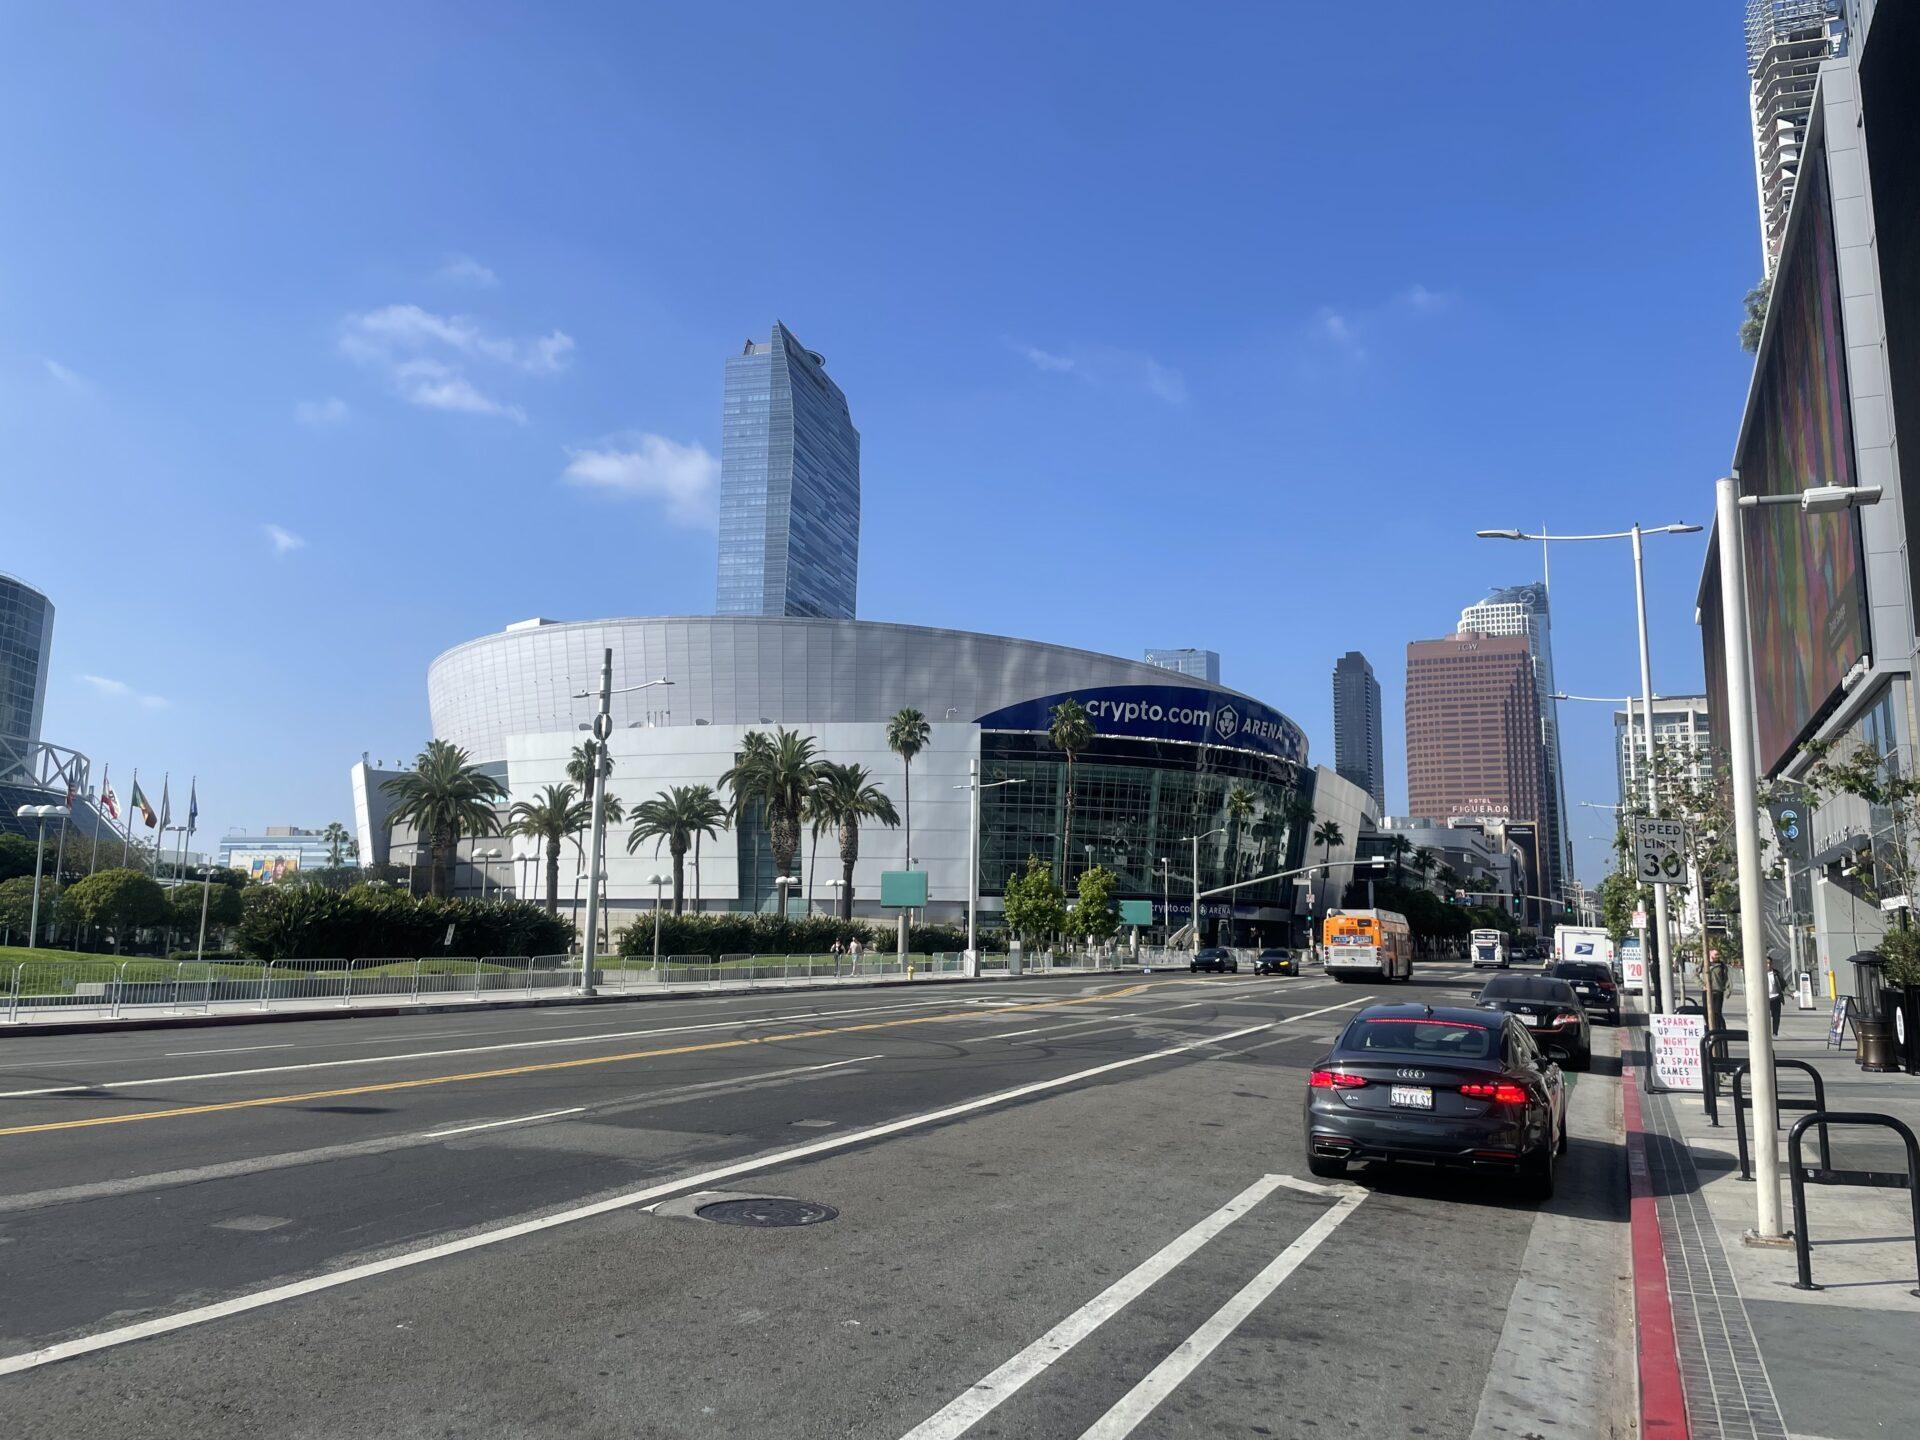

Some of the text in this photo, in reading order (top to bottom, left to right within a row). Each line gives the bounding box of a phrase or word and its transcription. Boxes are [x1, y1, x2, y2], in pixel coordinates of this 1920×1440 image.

[1085, 699, 1284, 741] crypto.com ARENA
[1452, 805, 1509, 813] FIGUEROA
[1639, 823, 1681, 835] SPEED
[1644, 838, 1677, 849] LIMIT
[1643, 853, 1681, 878] 30
[1208, 906, 1231, 915] ARENA
[1662, 1017, 1689, 1026] SPARK
[1657, 1027, 1700, 1037] UP THE
[1663, 1037, 1688, 1046] NIGHT
[1656, 1047, 1700, 1056] @33 DTL
[1655, 1057, 1699, 1067] LA SPARK
[1660, 1067, 1690, 1076] GAMES
